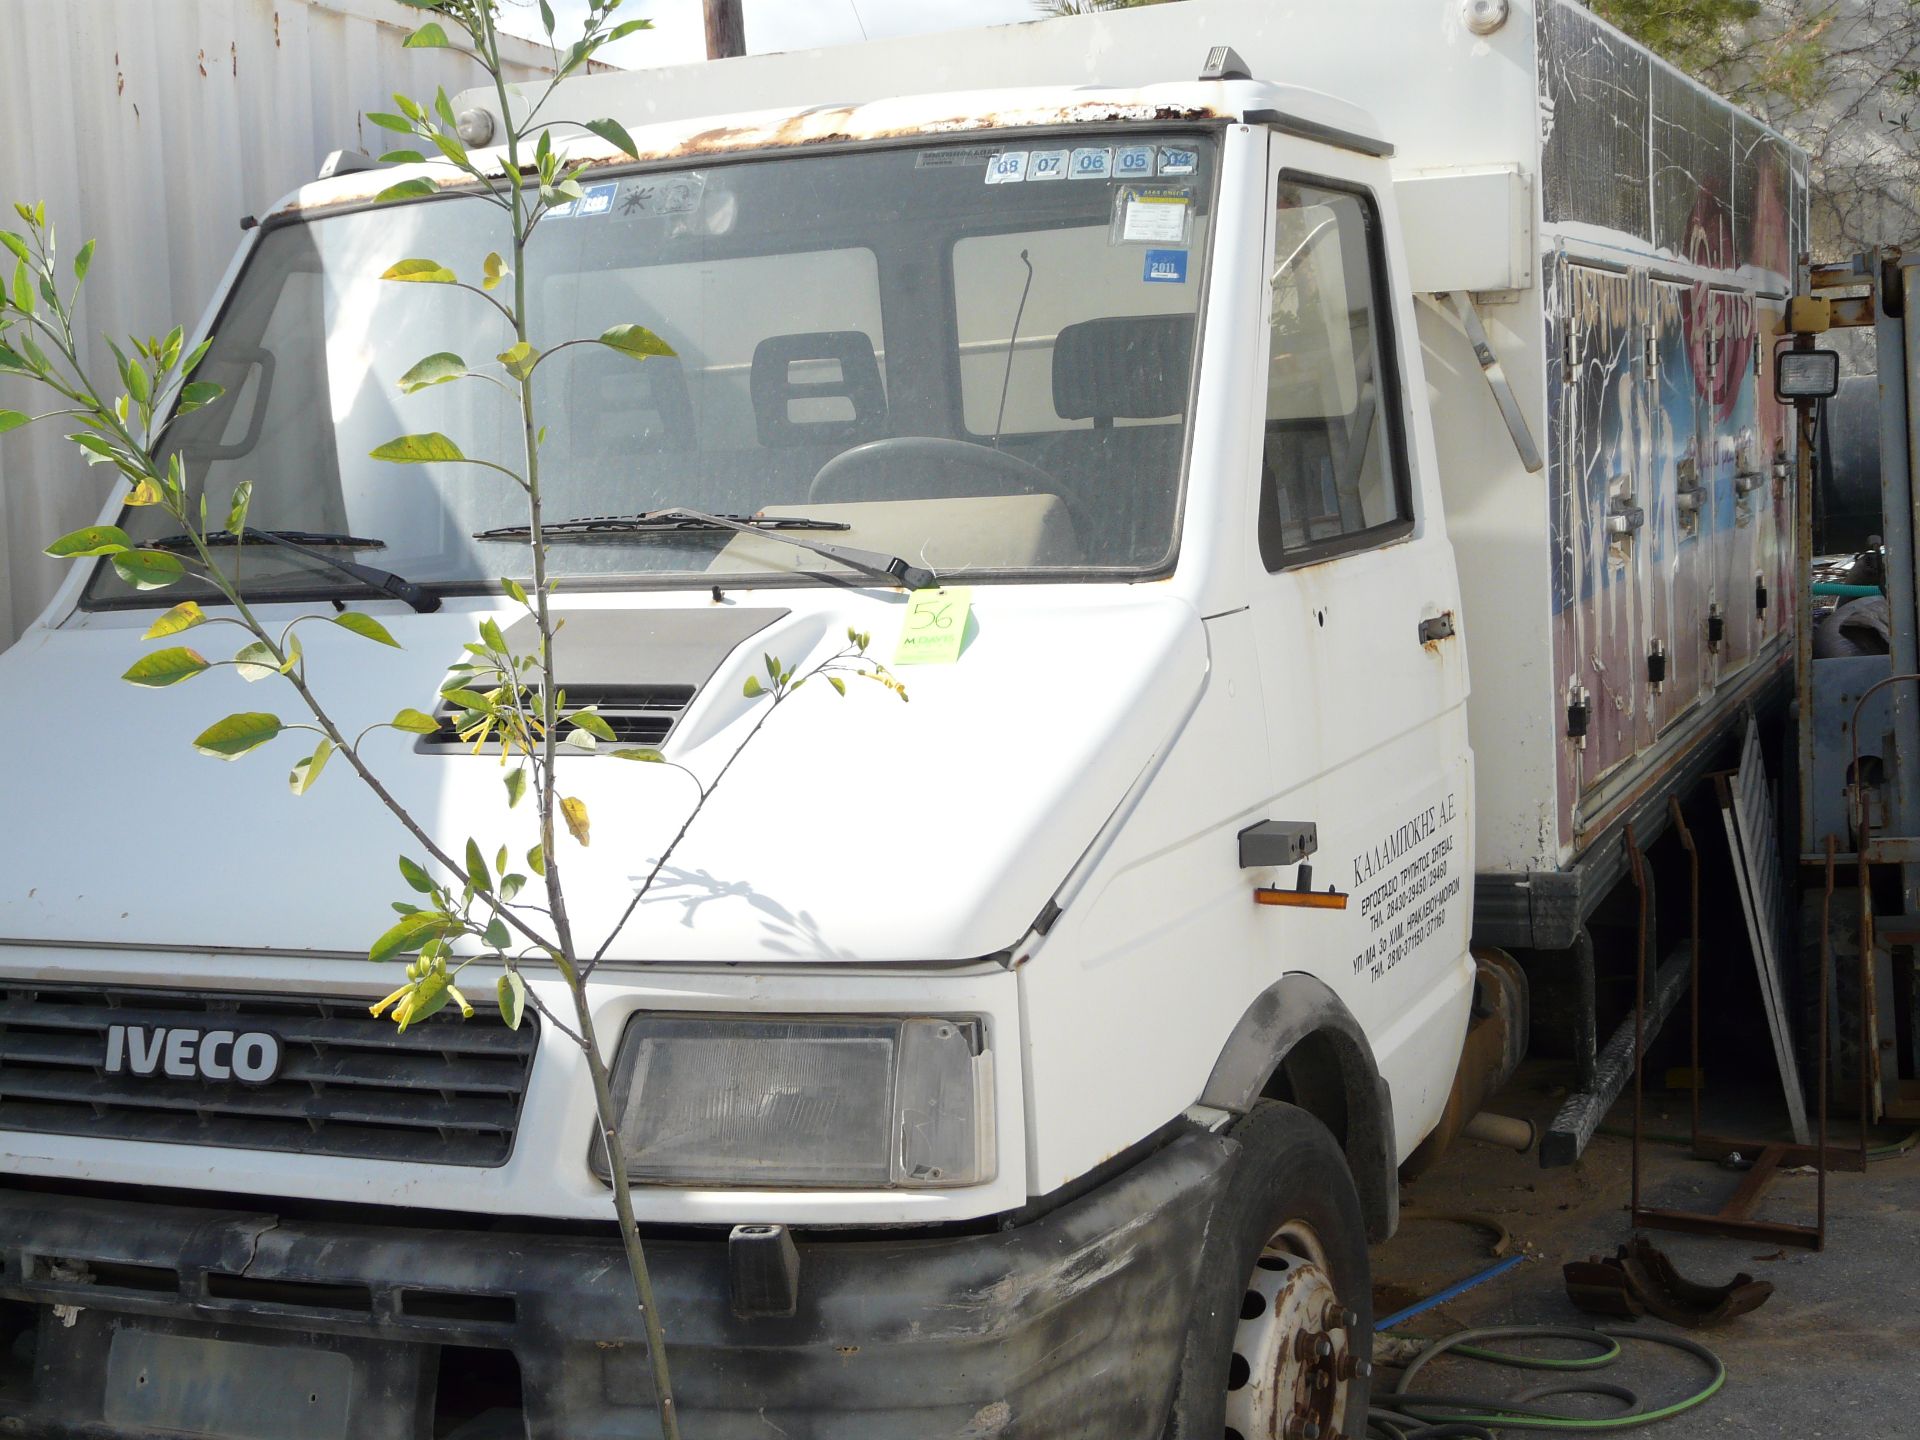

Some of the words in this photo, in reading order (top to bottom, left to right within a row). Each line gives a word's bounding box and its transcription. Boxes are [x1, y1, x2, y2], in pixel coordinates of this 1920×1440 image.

[997, 159, 1019, 174] 08
[1038, 157, 1061, 172] 07
[1080, 155, 1105, 169] 06
[1123, 153, 1147, 168] 05
[1168, 152, 1192, 166] 04
[1151, 262, 1176, 274] 2011
[910, 600, 953, 630] 56
[1353, 806, 1436, 889] ΚΑΛΑΜΠΟΚΗΣ
[1361, 875, 1398, 918] ΕΡΓΟΣΤΑΣΙΟ
[1400, 851, 1430, 888] ΤΡΥΠΗΤΟΣ
[1431, 834, 1453, 864] ΣΗΤΕΙΑΣ
[105, 1024, 279, 1083] IVECO
